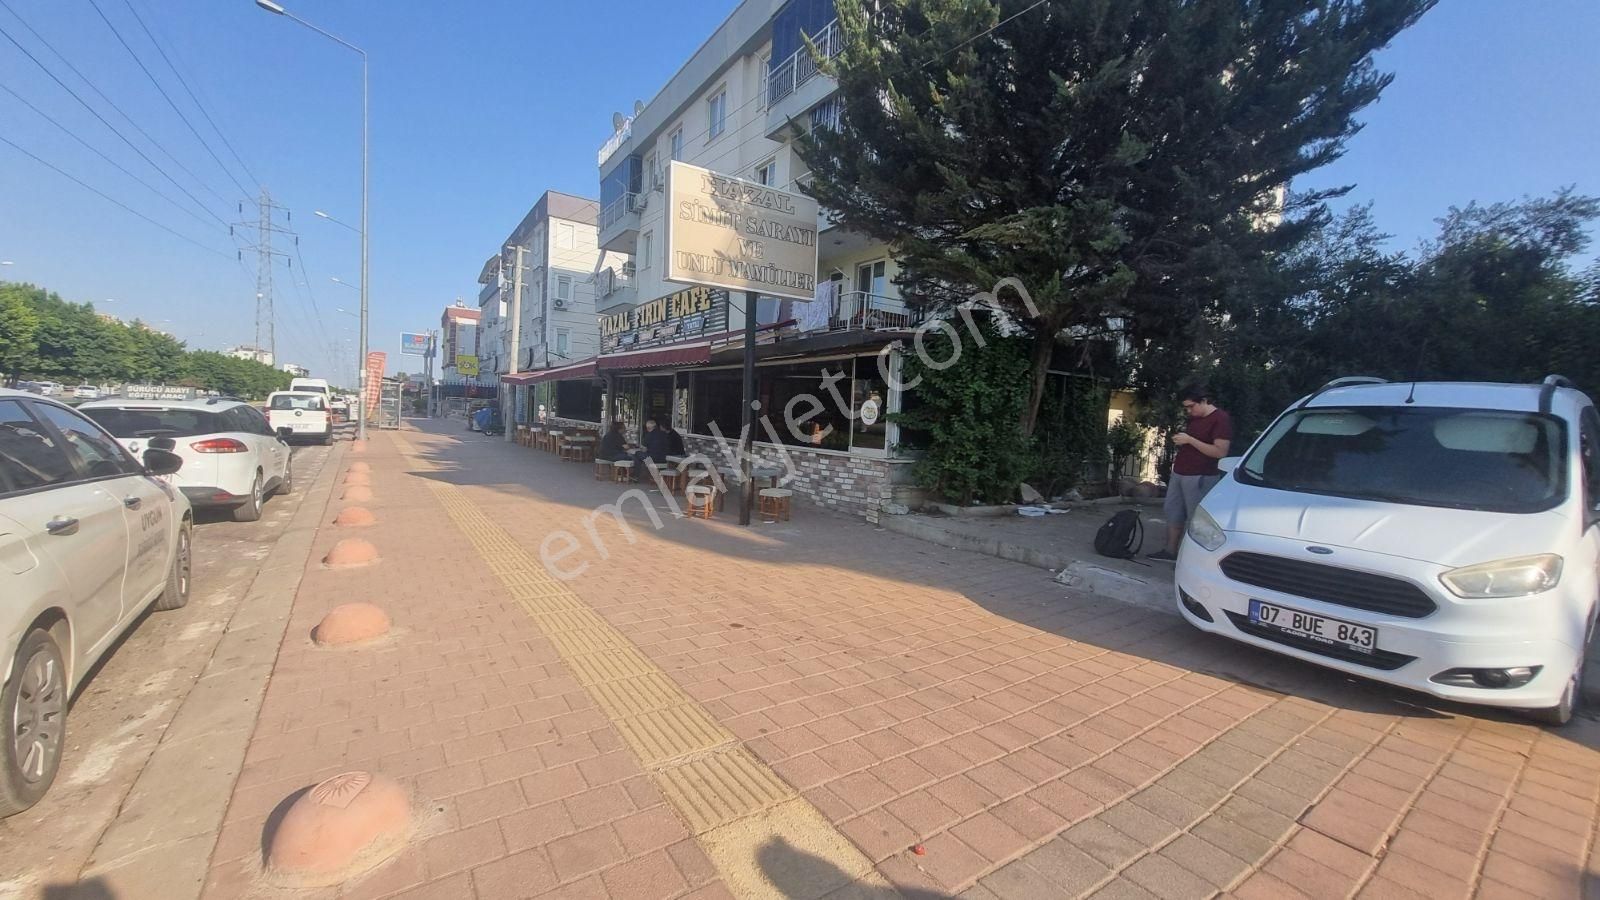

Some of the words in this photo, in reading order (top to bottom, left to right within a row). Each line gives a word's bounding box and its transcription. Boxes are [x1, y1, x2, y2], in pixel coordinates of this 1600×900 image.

[700, 174, 795, 215] HAZAL
[679, 198, 741, 231] SİMİT
[746, 216, 814, 247] SARAYI
[737, 237, 764, 260] VE
[728, 261, 815, 292] MAMÜLLER
[634, 298, 667, 328] FIRIN
[671, 287, 711, 318] CAFE
[127, 385, 162, 393] SÜRÜCÜ
[1260, 605, 1280, 623] 07
[1292, 613, 1325, 636] BUE
[1337, 624, 1373, 647] 843
